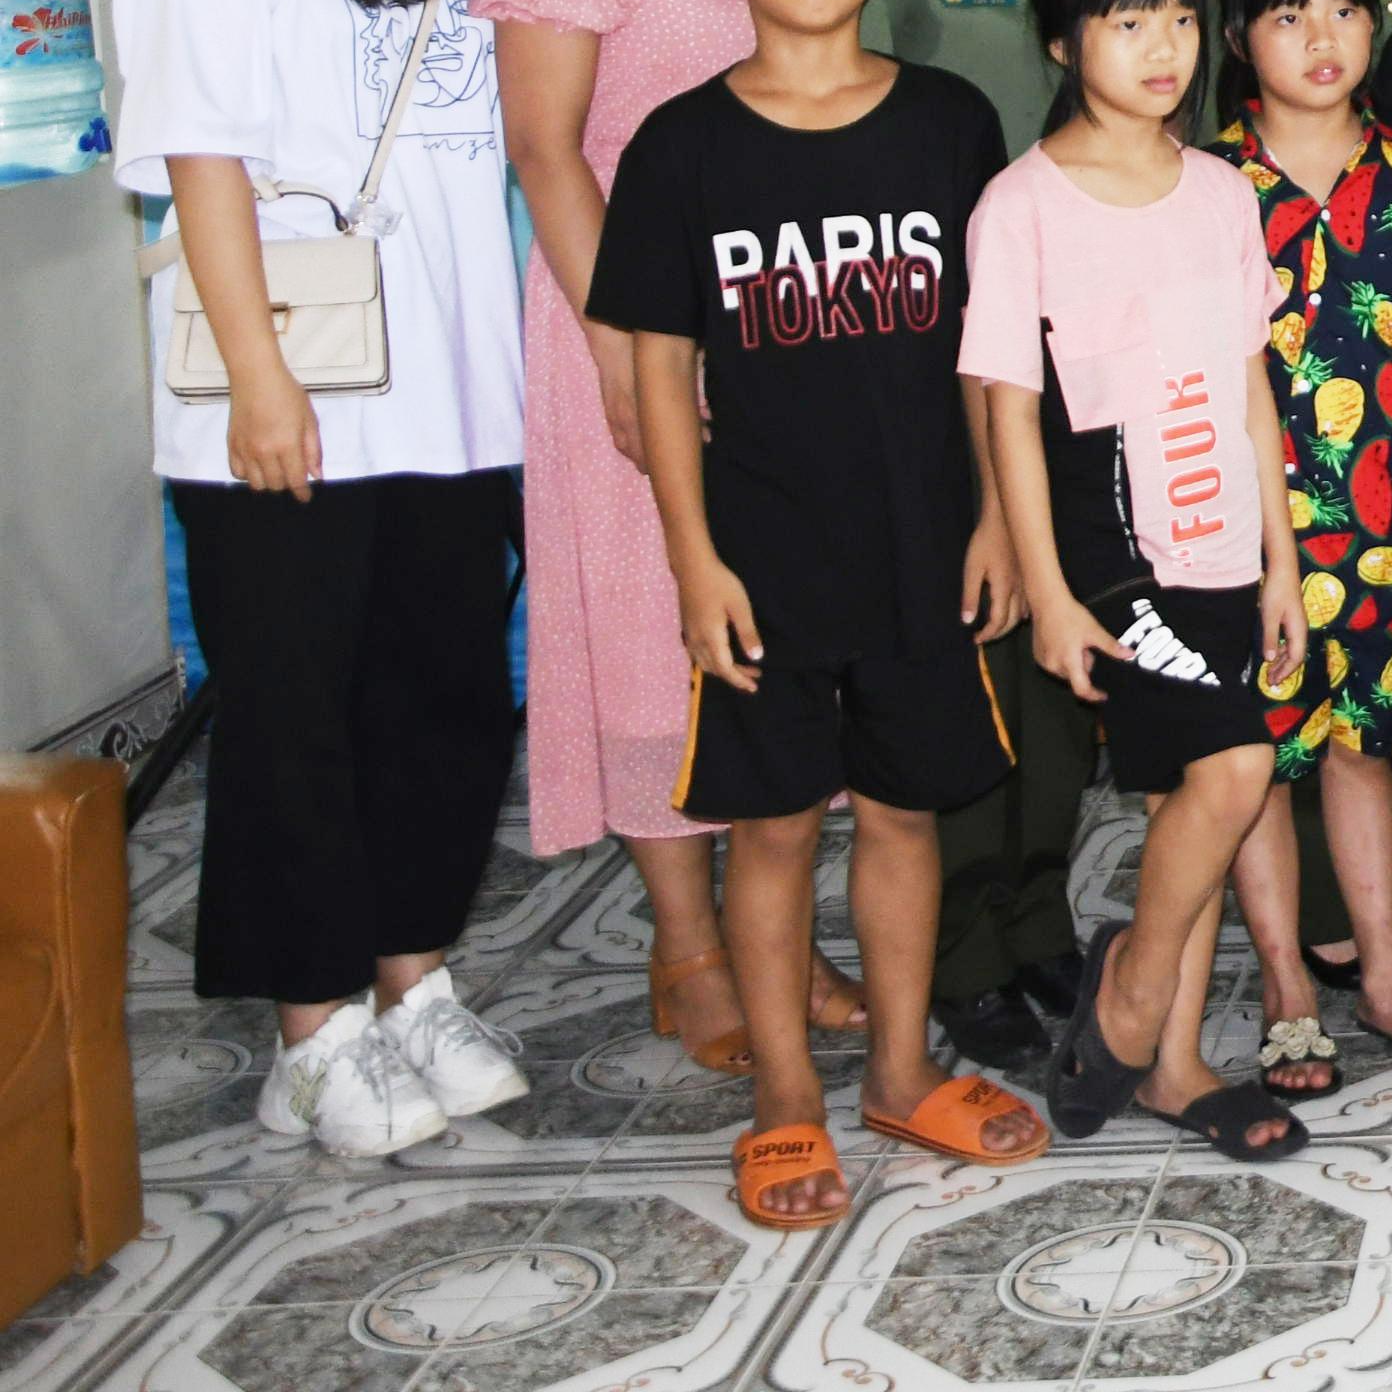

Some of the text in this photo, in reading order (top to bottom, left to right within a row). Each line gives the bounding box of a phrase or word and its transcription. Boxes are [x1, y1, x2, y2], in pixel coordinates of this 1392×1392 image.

[712, 210, 943, 311] PARIS
[720, 255, 942, 350] TOKYO
[751, 1140, 817, 1159] SPORT
